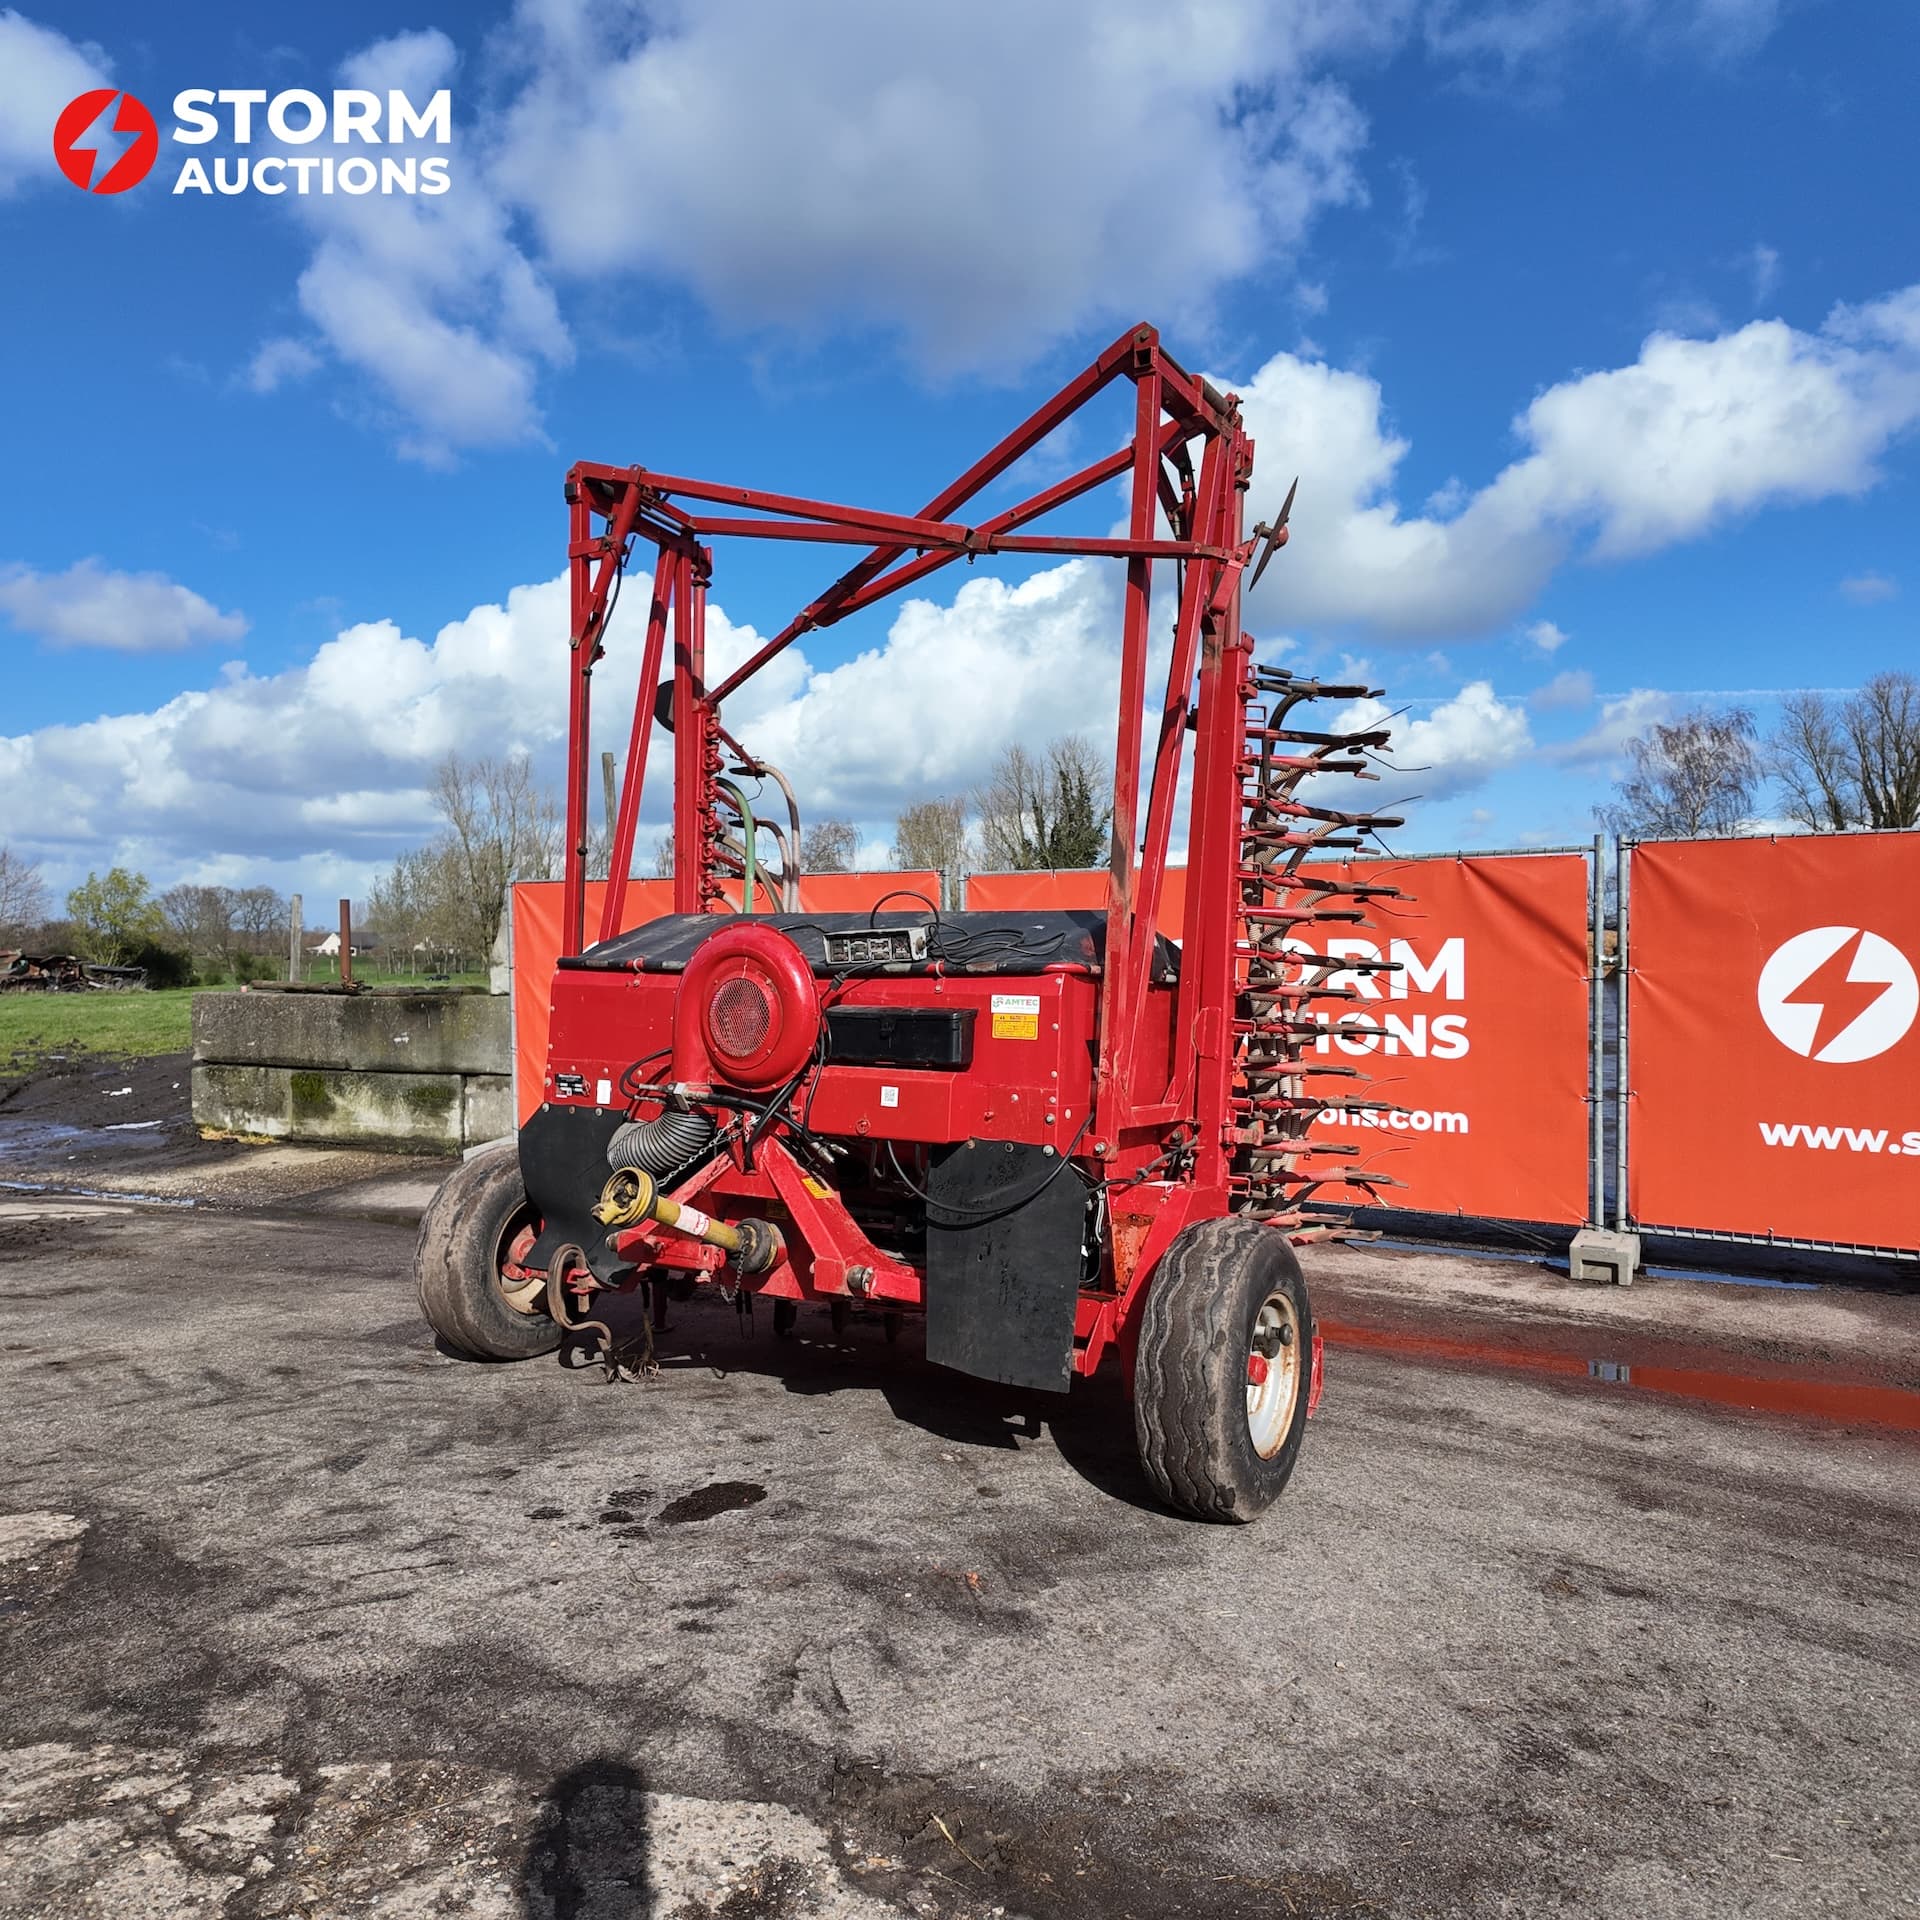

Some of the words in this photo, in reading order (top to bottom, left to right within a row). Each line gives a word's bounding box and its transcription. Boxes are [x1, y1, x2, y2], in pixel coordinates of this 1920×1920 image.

[1236, 937, 1465, 1001] ORM
[1005, 998, 1038, 1006] AMTEC
[1290, 1012, 1470, 1060] IONS
[1311, 1107, 1469, 1134] ons.com
